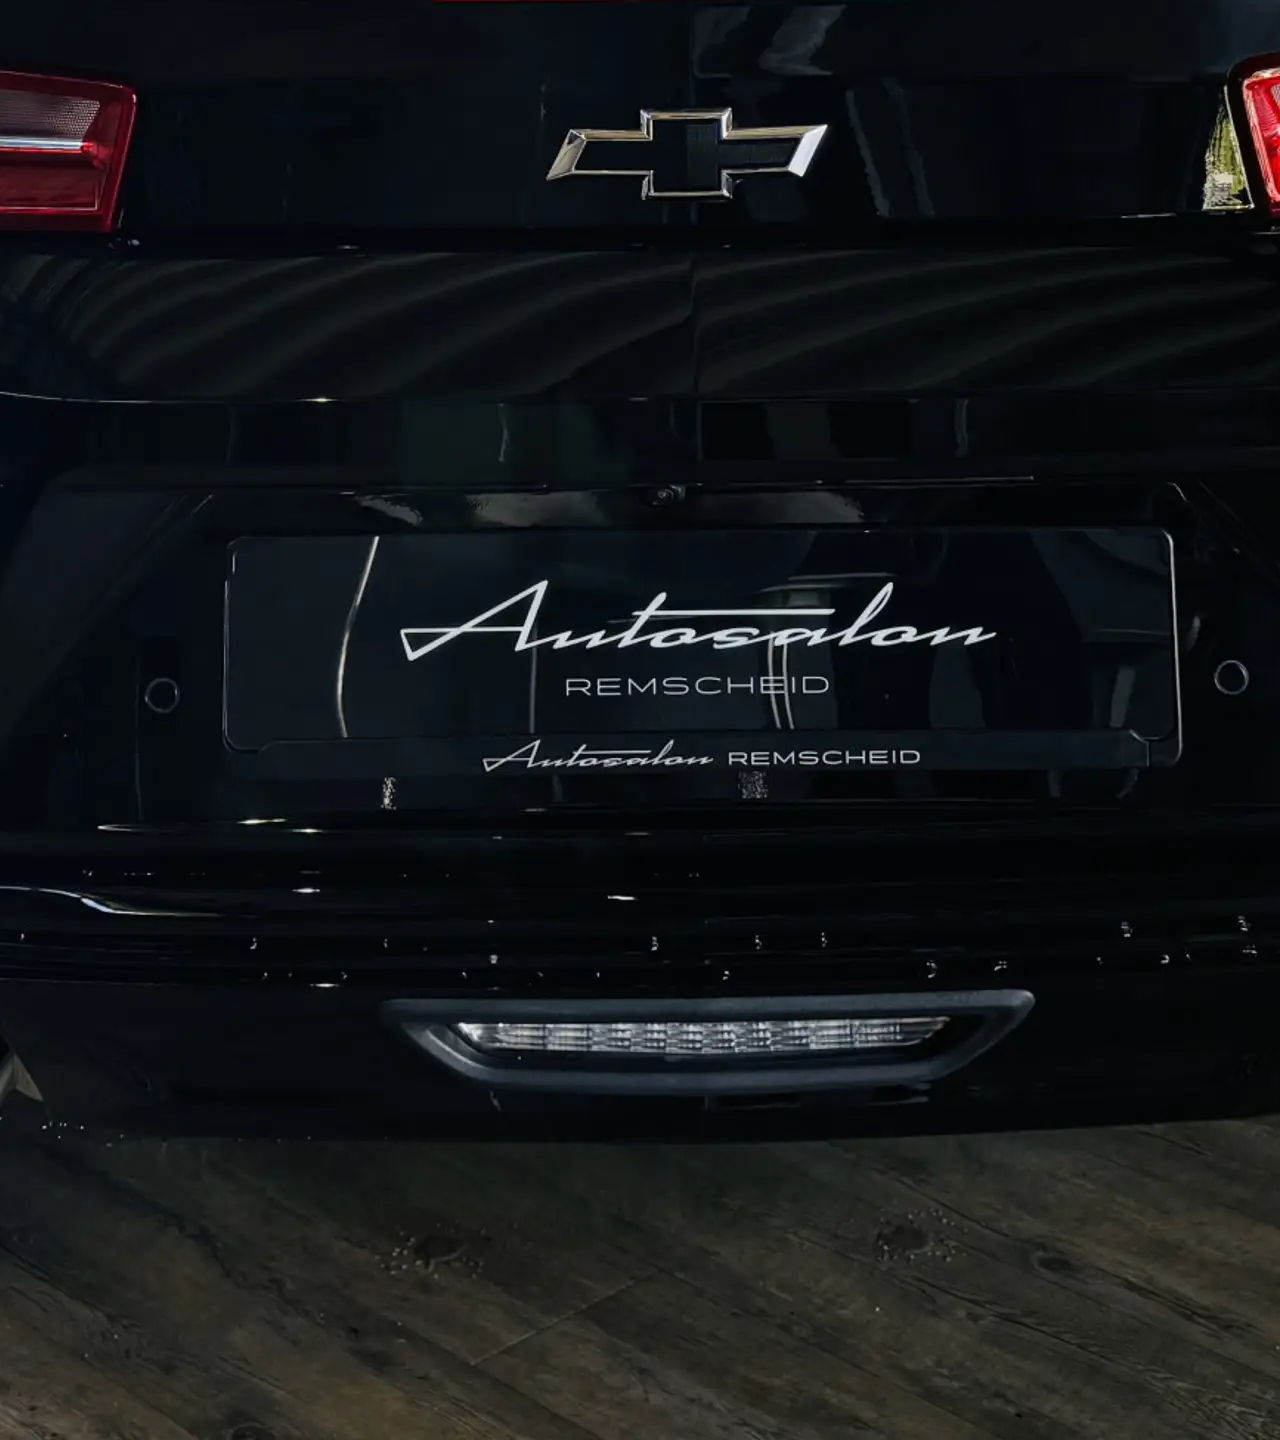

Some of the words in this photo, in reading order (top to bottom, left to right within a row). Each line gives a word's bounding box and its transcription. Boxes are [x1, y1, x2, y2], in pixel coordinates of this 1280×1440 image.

[399, 579, 997, 662] Autosalon
[565, 675, 830, 697] REMSCHEID
[482, 739, 715, 772] Autosalon
[727, 748, 921, 766] REMSCHEID
